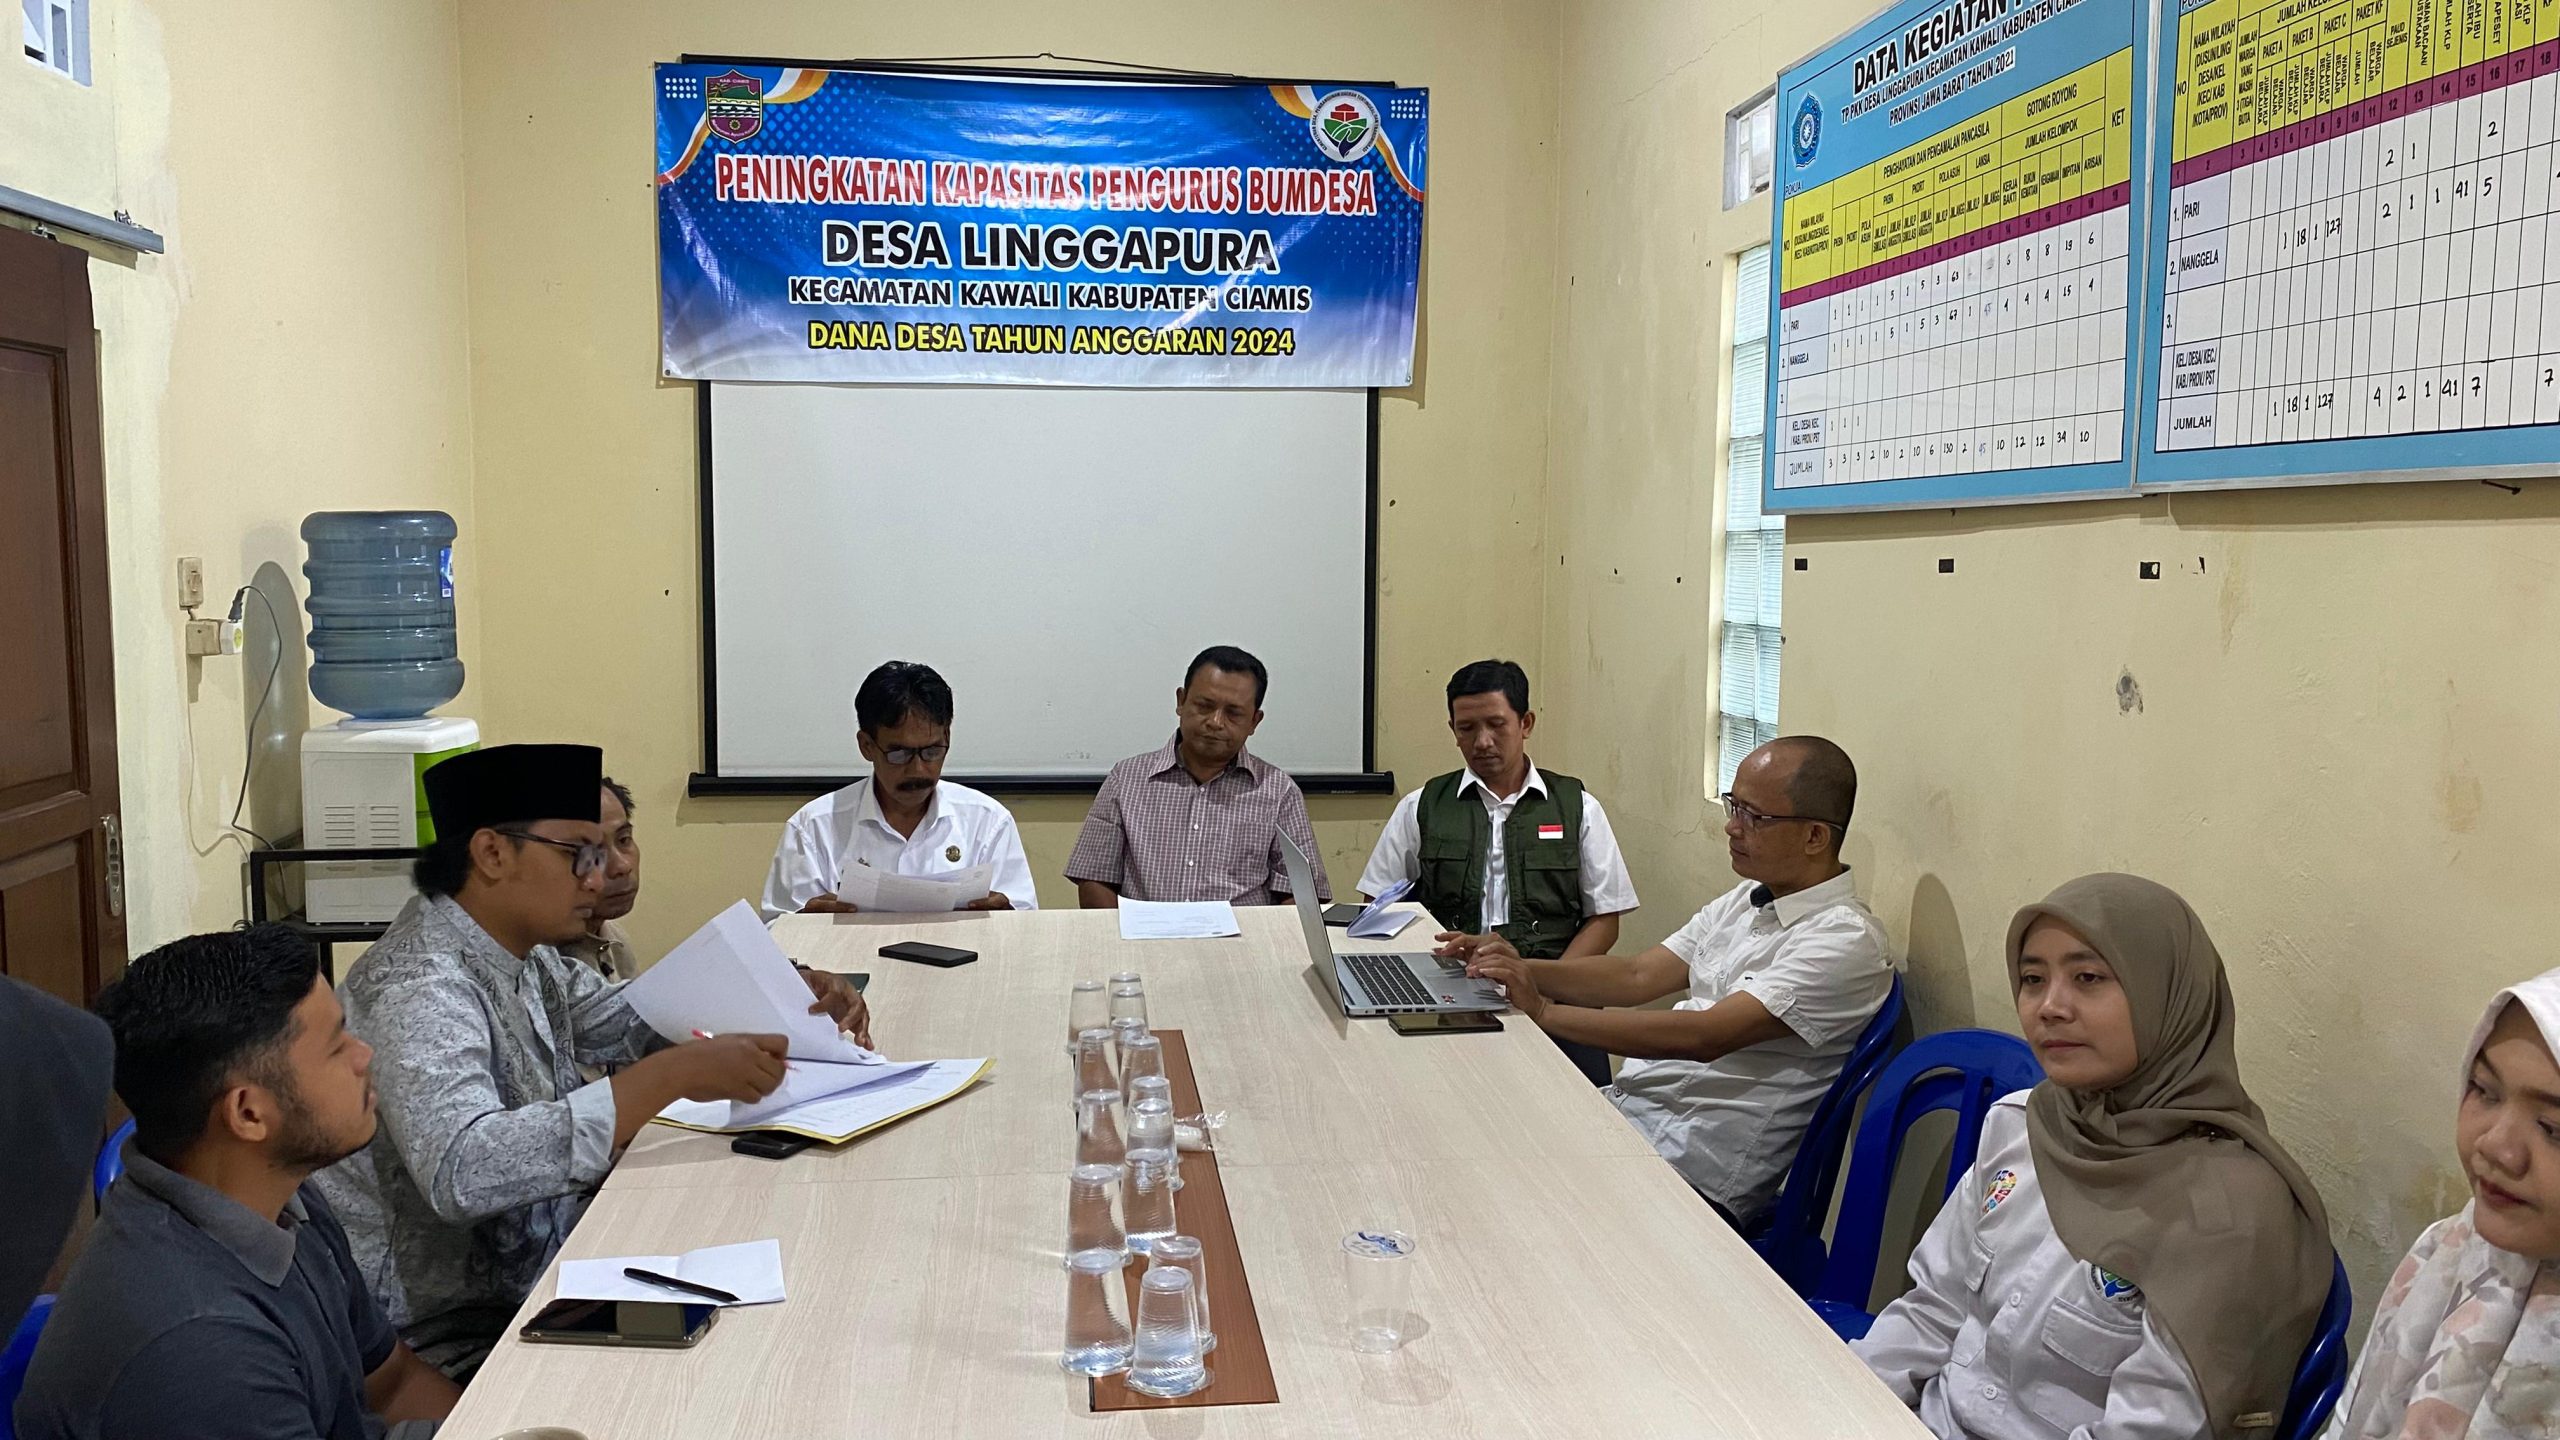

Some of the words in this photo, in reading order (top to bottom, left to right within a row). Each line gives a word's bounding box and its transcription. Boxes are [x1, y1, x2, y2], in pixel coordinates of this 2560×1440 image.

[2277, 2, 2306, 24] JUMLAH
[2323, 15, 2341, 35] PAKET
[2341, 13, 2347, 27] C
[2355, 3, 2375, 23] PAKET
[2523, 4, 2531, 25] KLP
[2210, 18, 2236, 42] WILAYAH
[2292, 29, 2309, 47] PAKET
[2308, 27, 2314, 41] B
[2473, 20, 2481, 39] IBU
[1841, 108, 1850, 124] TP
[1850, 103, 1863, 121] PKK
[1864, 94, 1881, 112] DESA
[1882, 73, 1924, 106] LINGGAPURA
[1925, 48, 1968, 79] KECAMATAN
[1969, 29, 2000, 57] KAWALI
[2001, 0, 2053, 42] KABUPATEN
[2262, 42, 2279, 60] PAKET
[2278, 40, 2283, 52] A
[2367, 41, 2376, 83] BELAJAR
[1853, 41, 1899, 95] DATA
[2354, 50, 2362, 86] JUMLAH
[1889, 101, 1921, 127] PROVINSI
[1922, 90, 1942, 110] JAWA
[1942, 77, 1966, 101] BARAT
[1967, 62, 1994, 88] TAHUN
[2026, 94, 2052, 117] GOTONG
[2051, 83, 2078, 106] ROYONG
[2177, 80, 2187, 97] NO
[2274, 137, 2279, 149] 5
[2289, 132, 2294, 144] 6
[2304, 126, 2310, 139] 7
[2368, 105, 2376, 118] 11
[2388, 98, 2398, 111] 12
[2414, 90, 2424, 104] 13
[2441, 81, 2450, 96] 14
[2465, 73, 2476, 88] 15
[2489, 66, 2500, 81] 16
[2514, 58, 2526, 74] 17
[2540, 51, 2551, 66] 18
[2046, 117, 2078, 141] KELOMPOK
[2111, 108, 2126, 128] KET
[2385, 149, 2394, 167] 2
[2487, 121, 2498, 137] 2
[717, 156, 924, 204] PENINGKATAN
[934, 163, 1084, 207] KAPASITAS
[1092, 168, 1241, 212] PENGURUS
[1249, 169, 1376, 214] BUMDESA
[2174, 207, 2180, 222] 1.
[2184, 201, 2200, 219] PARI
[2297, 228, 2307, 248] 18
[2326, 217, 2341, 238] 127
[2382, 203, 2392, 218] 2
[2455, 180, 2469, 199] 41
[2483, 176, 2493, 197] 5
[824, 221, 950, 267] DESA
[963, 223, 1278, 272] LINGGAPURA
[2025, 248, 2031, 261] 8
[2045, 243, 2050, 256] 8
[2088, 231, 2095, 244] 6
[2169, 261, 2177, 276] 2.
[2181, 249, 2219, 272] NANGGELA
[790, 277, 951, 305] KECAMATAN
[961, 283, 1060, 307] KAWALI
[1068, 285, 1216, 310] KABUPATEN
[1225, 287, 1311, 311] CIAMIS
[2063, 285, 2072, 297] 15
[2166, 313, 2173, 329] 3.
[809, 321, 889, 349] DANA
[897, 324, 965, 351] DESA
[971, 325, 1064, 352] TAHUN
[1072, 327, 1226, 354] ANGGARAN
[1232, 329, 1294, 355] 2024
[2287, 396, 2298, 413] 18
[2317, 392, 2334, 410] 127
[2374, 386, 2381, 407] 4
[2397, 385, 2407, 401] 2
[2424, 380, 2431, 397] 1
[2441, 378, 2458, 397] 41
[2471, 376, 2481, 397] 7
[2544, 368, 2554, 387] 7
[2173, 415, 2212, 430] JUMLAH
[1997, 439, 2005, 450] 10
[2015, 436, 2026, 448] 12
[2036, 436, 2045, 447] 12
[2080, 431, 2090, 442] 10
